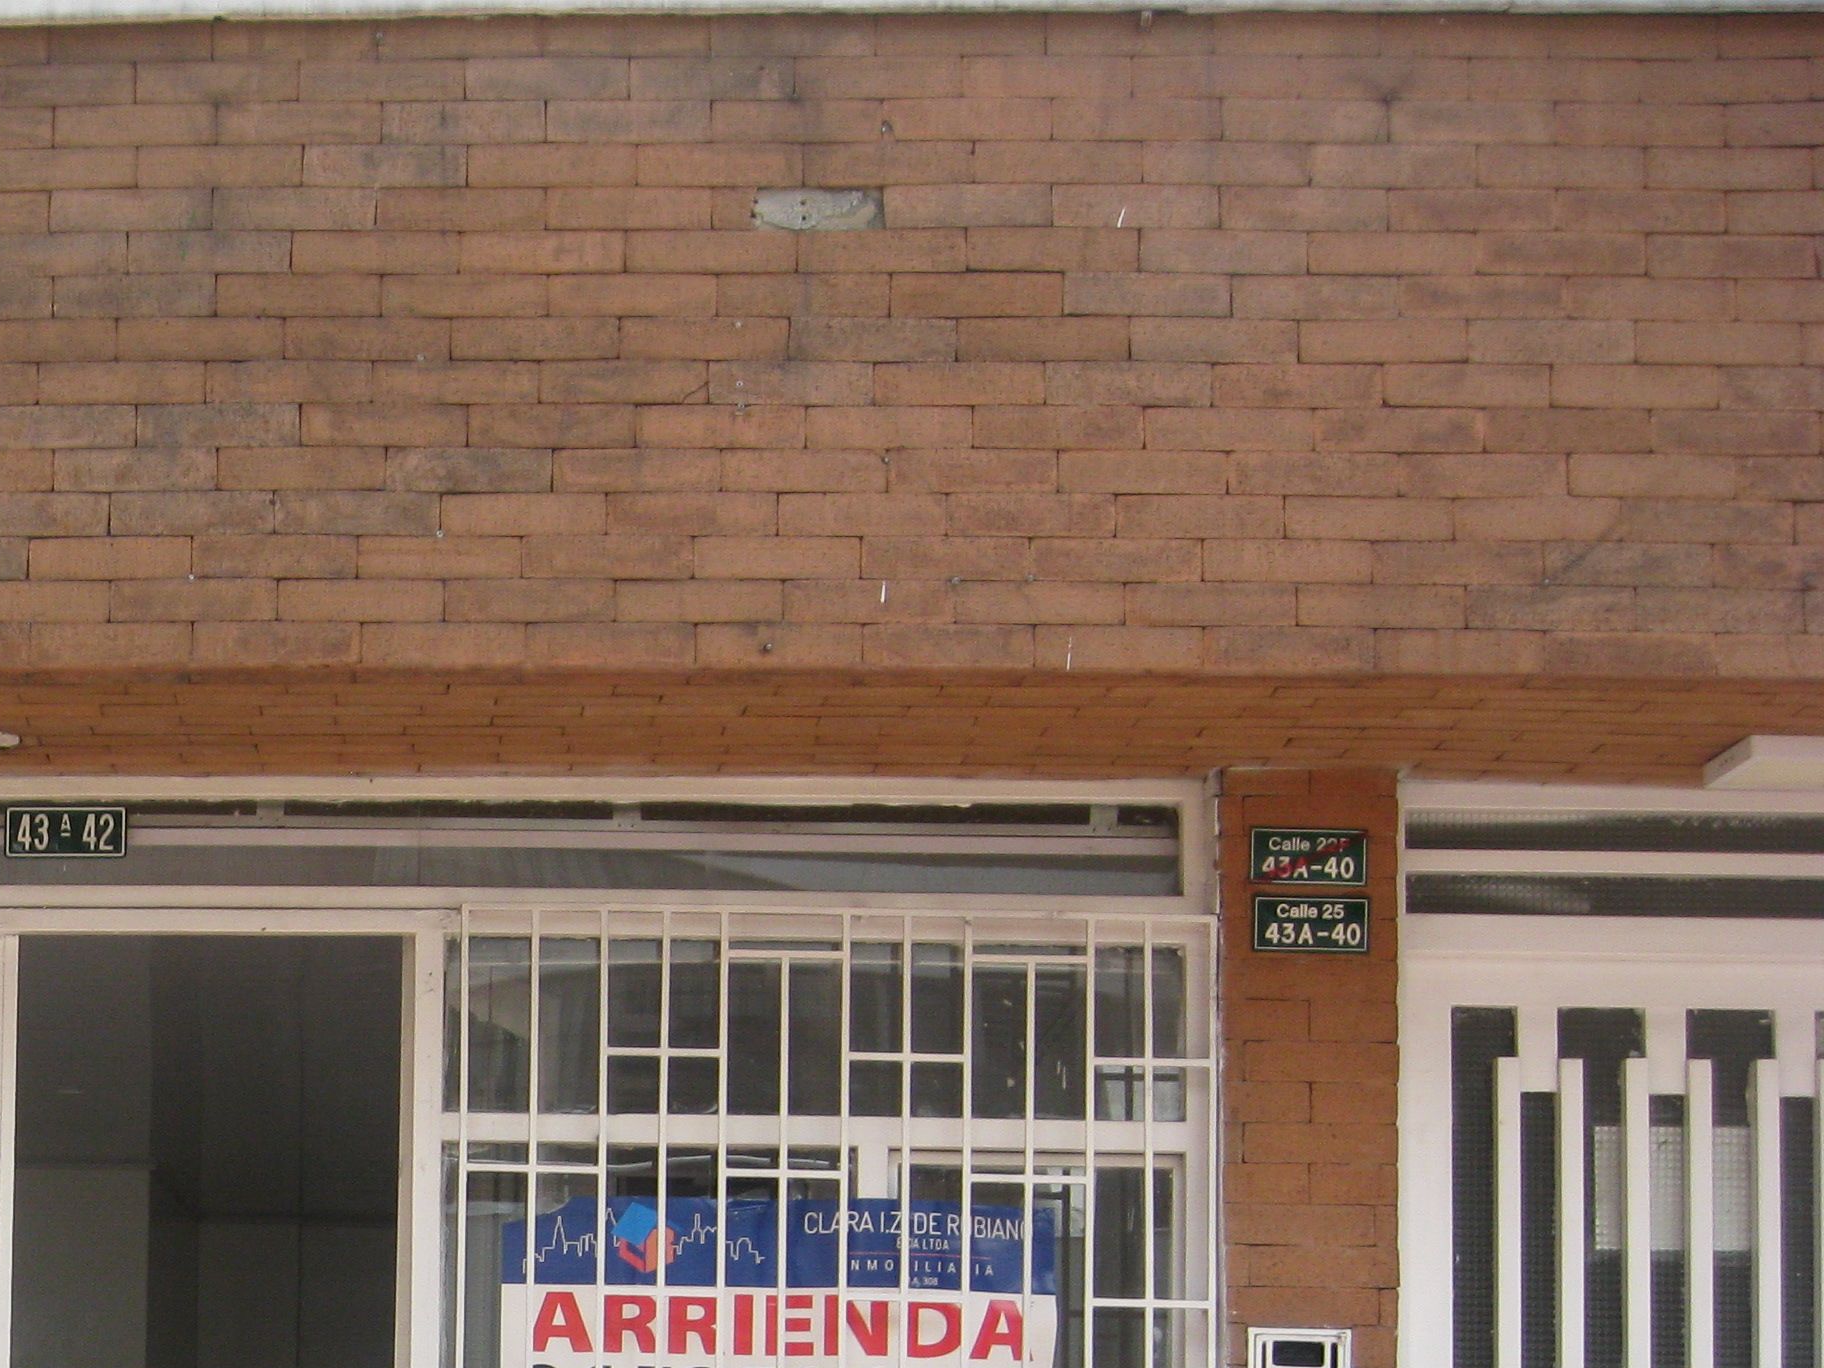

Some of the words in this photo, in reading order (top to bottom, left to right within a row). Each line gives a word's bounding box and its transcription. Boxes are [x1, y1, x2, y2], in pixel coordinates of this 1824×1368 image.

[17, 813, 49, 850] 43
[60, 813, 71, 836] A
[82, 813, 114, 850] 42
[1268, 836, 1311, 852] Calle
[1262, 855, 1355, 879] 43A-40
[1276, 903, 1318, 919] Calle
[1322, 904, 1345, 920] 25
[1264, 922, 1361, 946] 43A-40
[804, 1210, 874, 1235] CLARA
[914, 1212, 942, 1236] DE
[947, 1214, 1033, 1240] RBIAN
[843, 1259, 994, 1276] NMOILIAIA
[532, 1291, 1033, 1361] ARRIENDA
